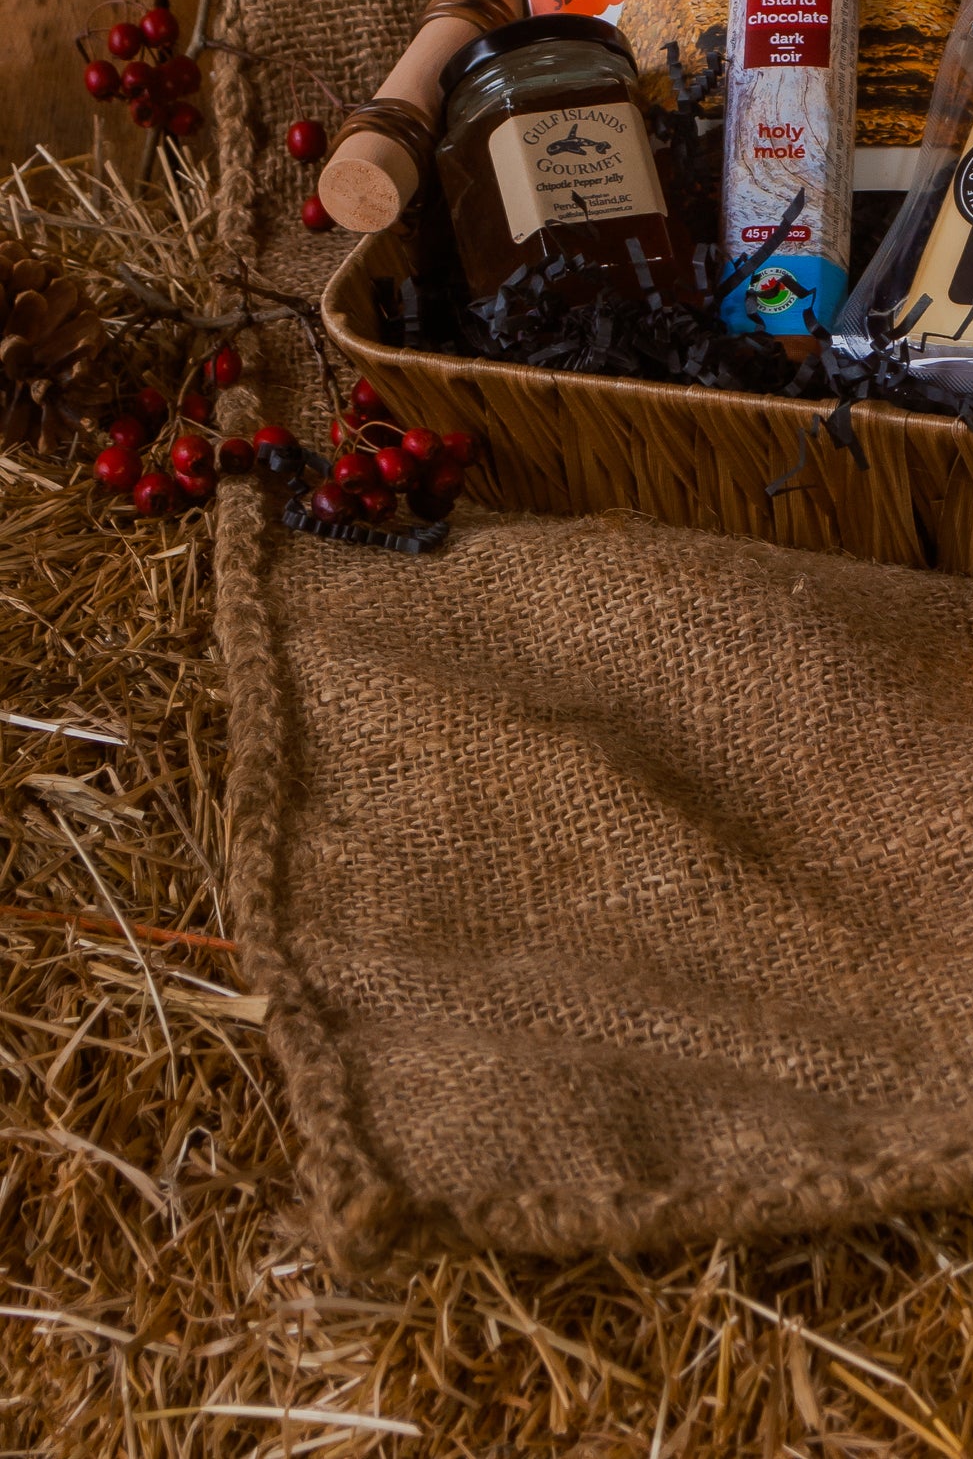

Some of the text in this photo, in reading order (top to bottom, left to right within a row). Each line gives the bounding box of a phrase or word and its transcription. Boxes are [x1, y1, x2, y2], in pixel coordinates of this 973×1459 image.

[748, 10, 829, 25] chocolate
[769, 32, 805, 44] dark
[769, 51, 802, 62] noir
[522, 108, 628, 146] GULF ISLANDS
[758, 122, 804, 142] holy
[754, 144, 806, 159] molé
[536, 151, 624, 176] GOURMET
[536, 172, 624, 192] Chipotle Pepper Jelly
[553, 201, 578, 212] Pend
